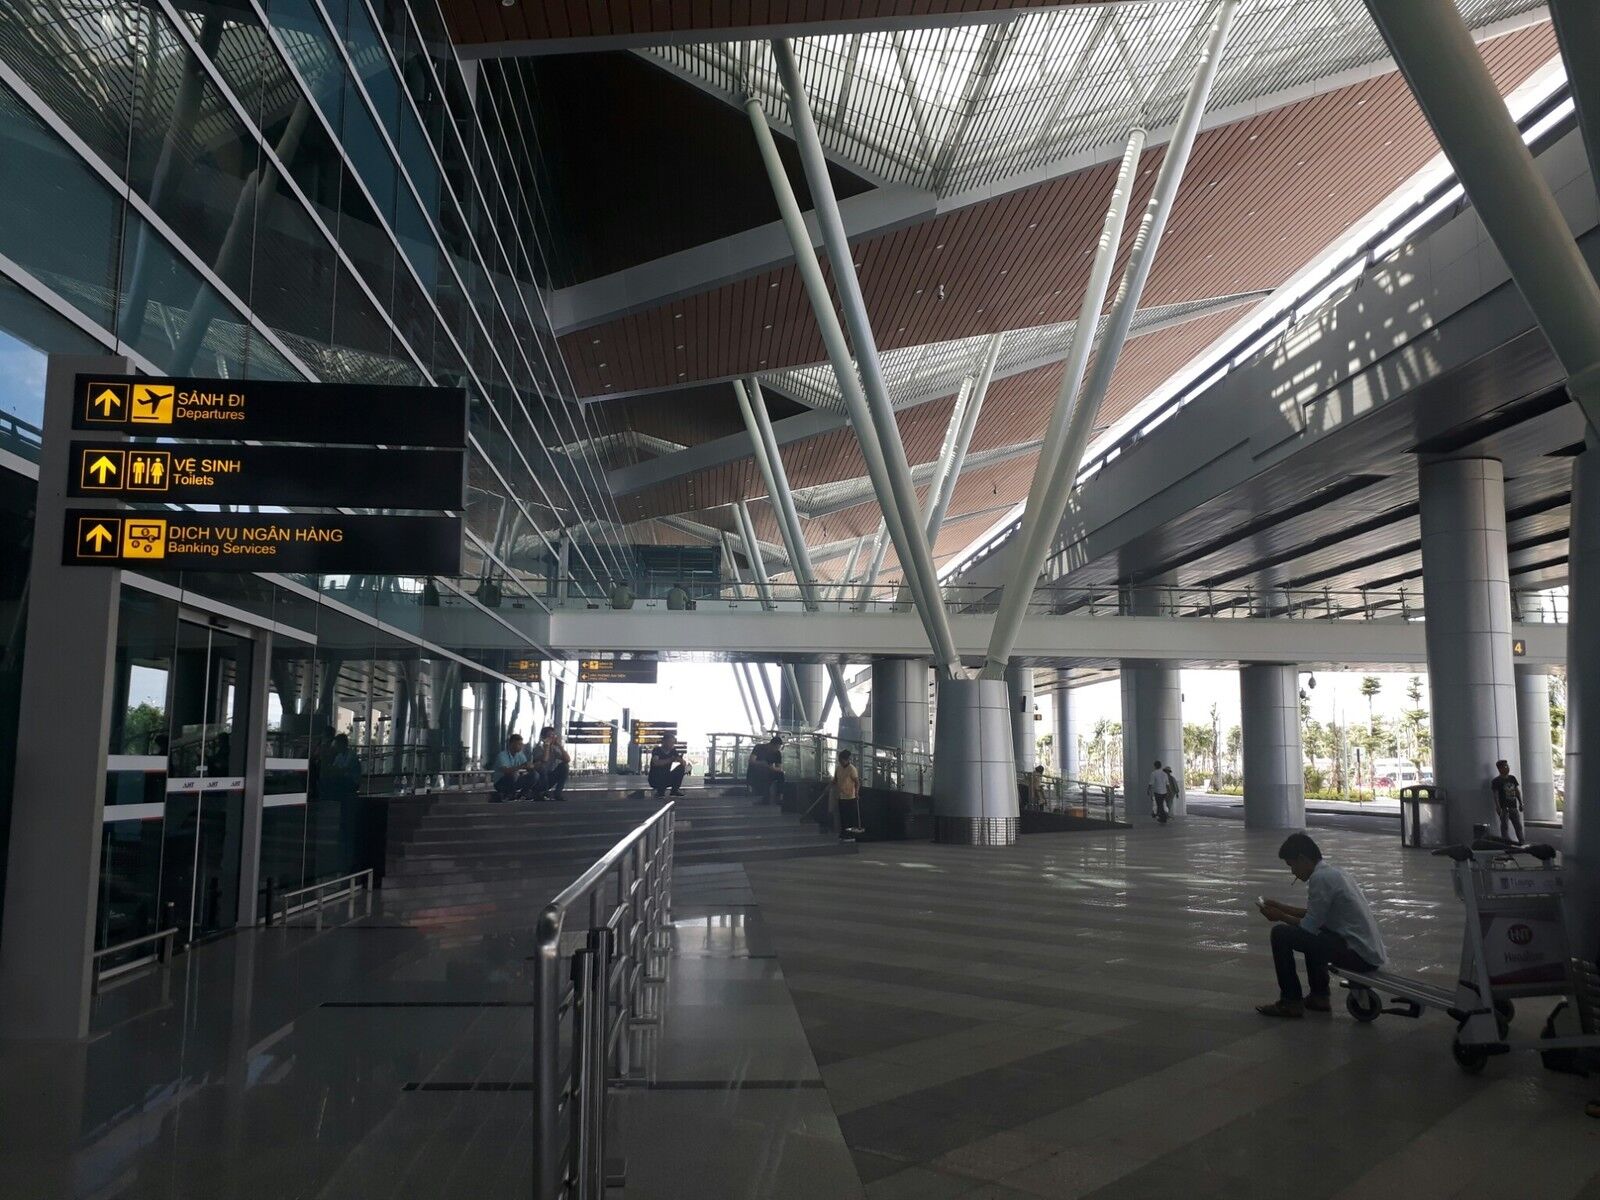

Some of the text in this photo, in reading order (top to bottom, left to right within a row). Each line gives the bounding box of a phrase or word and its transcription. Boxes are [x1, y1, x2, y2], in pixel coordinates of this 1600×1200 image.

[177, 390, 245, 407] SẢNH ĐI
[176, 407, 246, 421] Departures
[174, 457, 241, 474] VỆ SINH
[173, 472, 214, 486] Toilets
[169, 525, 343, 543] DỊCH VỤ NGÂN HÀNG
[168, 541, 277, 557] Banking Services
[1514, 641, 1524, 654] 4
